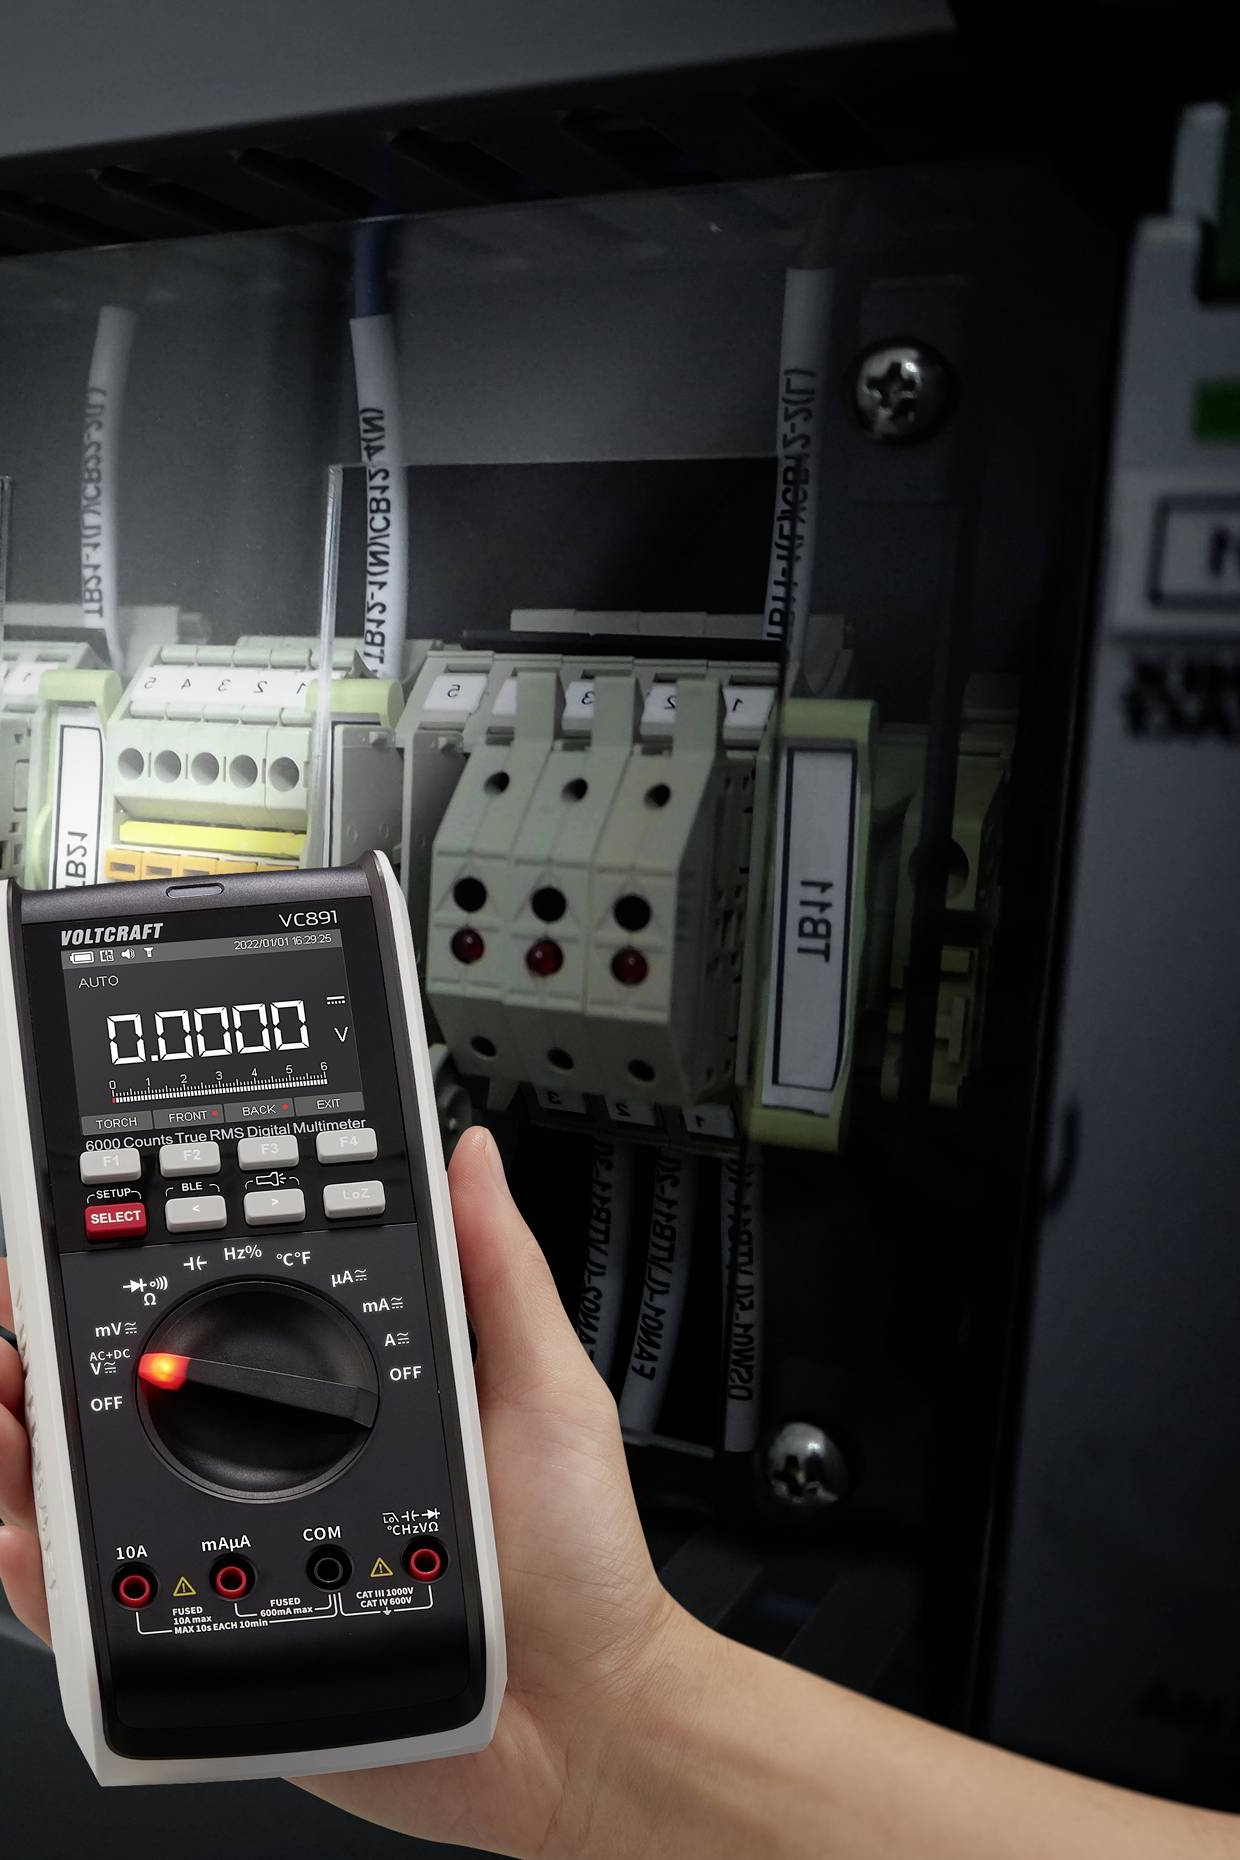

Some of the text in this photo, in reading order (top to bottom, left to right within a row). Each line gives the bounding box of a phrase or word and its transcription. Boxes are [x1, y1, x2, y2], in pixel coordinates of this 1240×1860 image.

[278, 910, 338, 927] VC891
[61, 922, 164, 946] VOLTCRAFT
[234, 933, 332, 950] 2022/01/01 16:29:25
[78, 975, 119, 989] AUTO
[106, 1000, 310, 1066] 0.0000
[334, 1026, 349, 1042] V
[109, 1061, 328, 1090] 0 1 2 3 4 5 6
[96, 1097, 341, 1130] TORCH FRONT BACK EXIT
[85, 1118, 366, 1152] 6000 Counts True RMS Digital Multimeter
[339, 1136, 359, 1148] F4
[183, 1149, 201, 1161] F2
[261, 1143, 279, 1156] F3
[103, 1155, 120, 1167] F1
[95, 1188, 132, 1199] SETUP
[181, 1181, 203, 1192] BLE
[342, 1188, 370, 1199] LoZ
[90, 1210, 141, 1225] SELECT
[223, 1245, 263, 1262] Hz%
[362, 1298, 390, 1313] mA
[95, 1322, 122, 1337] mV
[384, 1333, 396, 1347] A
[89, 1348, 131, 1362] AC+DC
[389, 1366, 422, 1381] OFF
[90, 1396, 123, 1412] OFF
[302, 1525, 342, 1542] COM
[115, 1544, 148, 1561] 10A
[356, 1587, 414, 1599] CAT III 1000V
[270, 1597, 301, 1607] FUSED
[360, 1596, 412, 1608] CAT IV 600V
[172, 1606, 203, 1616] FUSED
[260, 1606, 313, 1617] 600mA max
[173, 1615, 212, 1625] 10A max
[174, 1618, 268, 1635] MAX 10s EACH 10min
